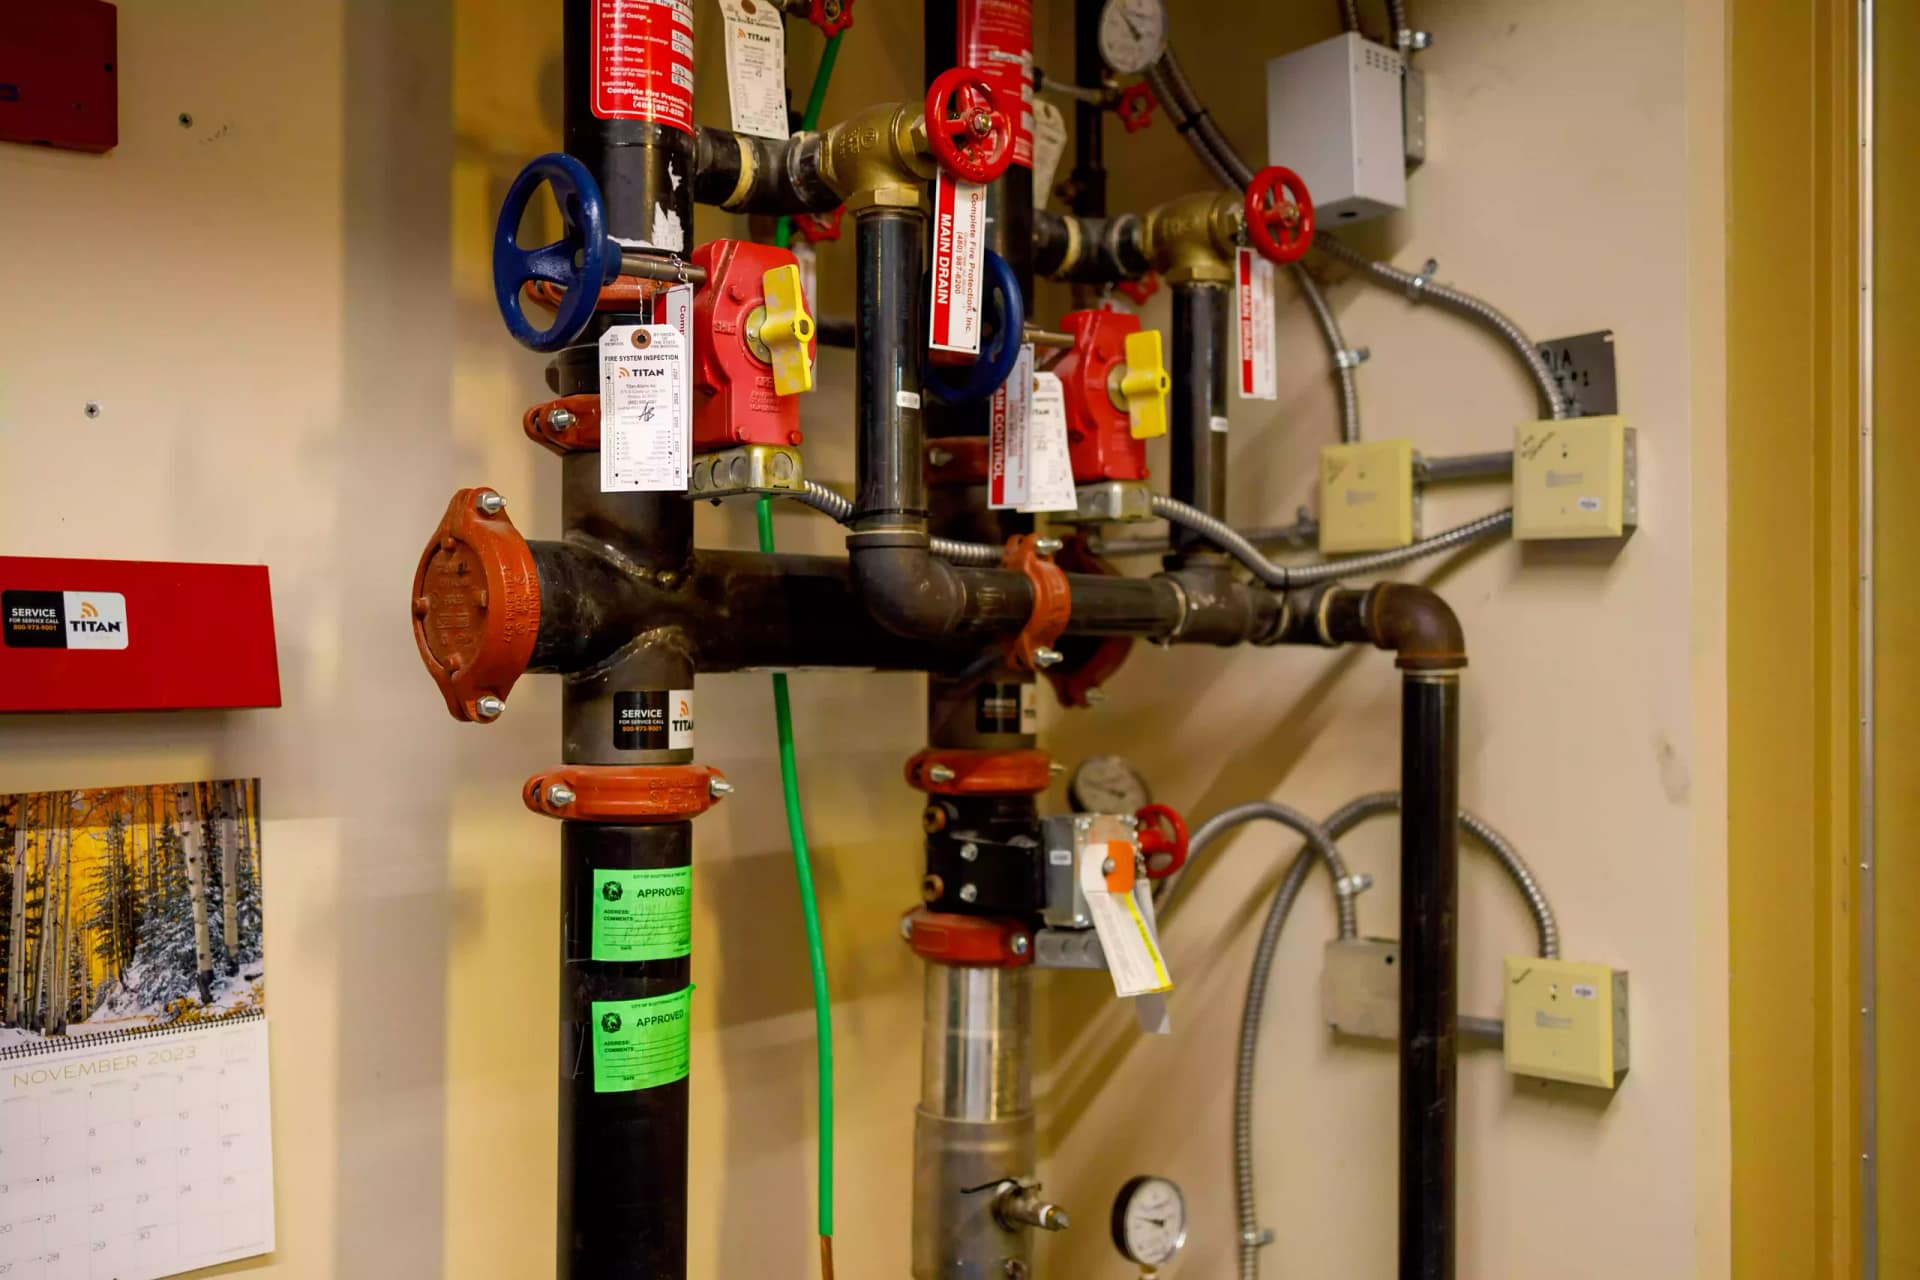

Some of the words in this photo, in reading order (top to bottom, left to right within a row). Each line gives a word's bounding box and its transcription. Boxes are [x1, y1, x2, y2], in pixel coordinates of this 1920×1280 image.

[747, 33, 770, 42] TITAN
[970, 192, 979, 239] Complete
[940, 213, 953, 253] MAIN
[968, 240, 977, 259] Fire
[936, 257, 950, 305] DRAIN
[995, 388, 1005, 410] AIN
[993, 413, 1005, 480] CONTROL
[11, 608, 56, 617] SERVICE
[69, 620, 121, 633] TITAN
[622, 709, 662, 718] SERVICE
[636, 886, 685, 898] APPROVED
[636, 1009, 684, 1028] APPROVED
[12, 1053, 139, 1088] NOVEMBER
[147, 1045, 197, 1065] 2023
